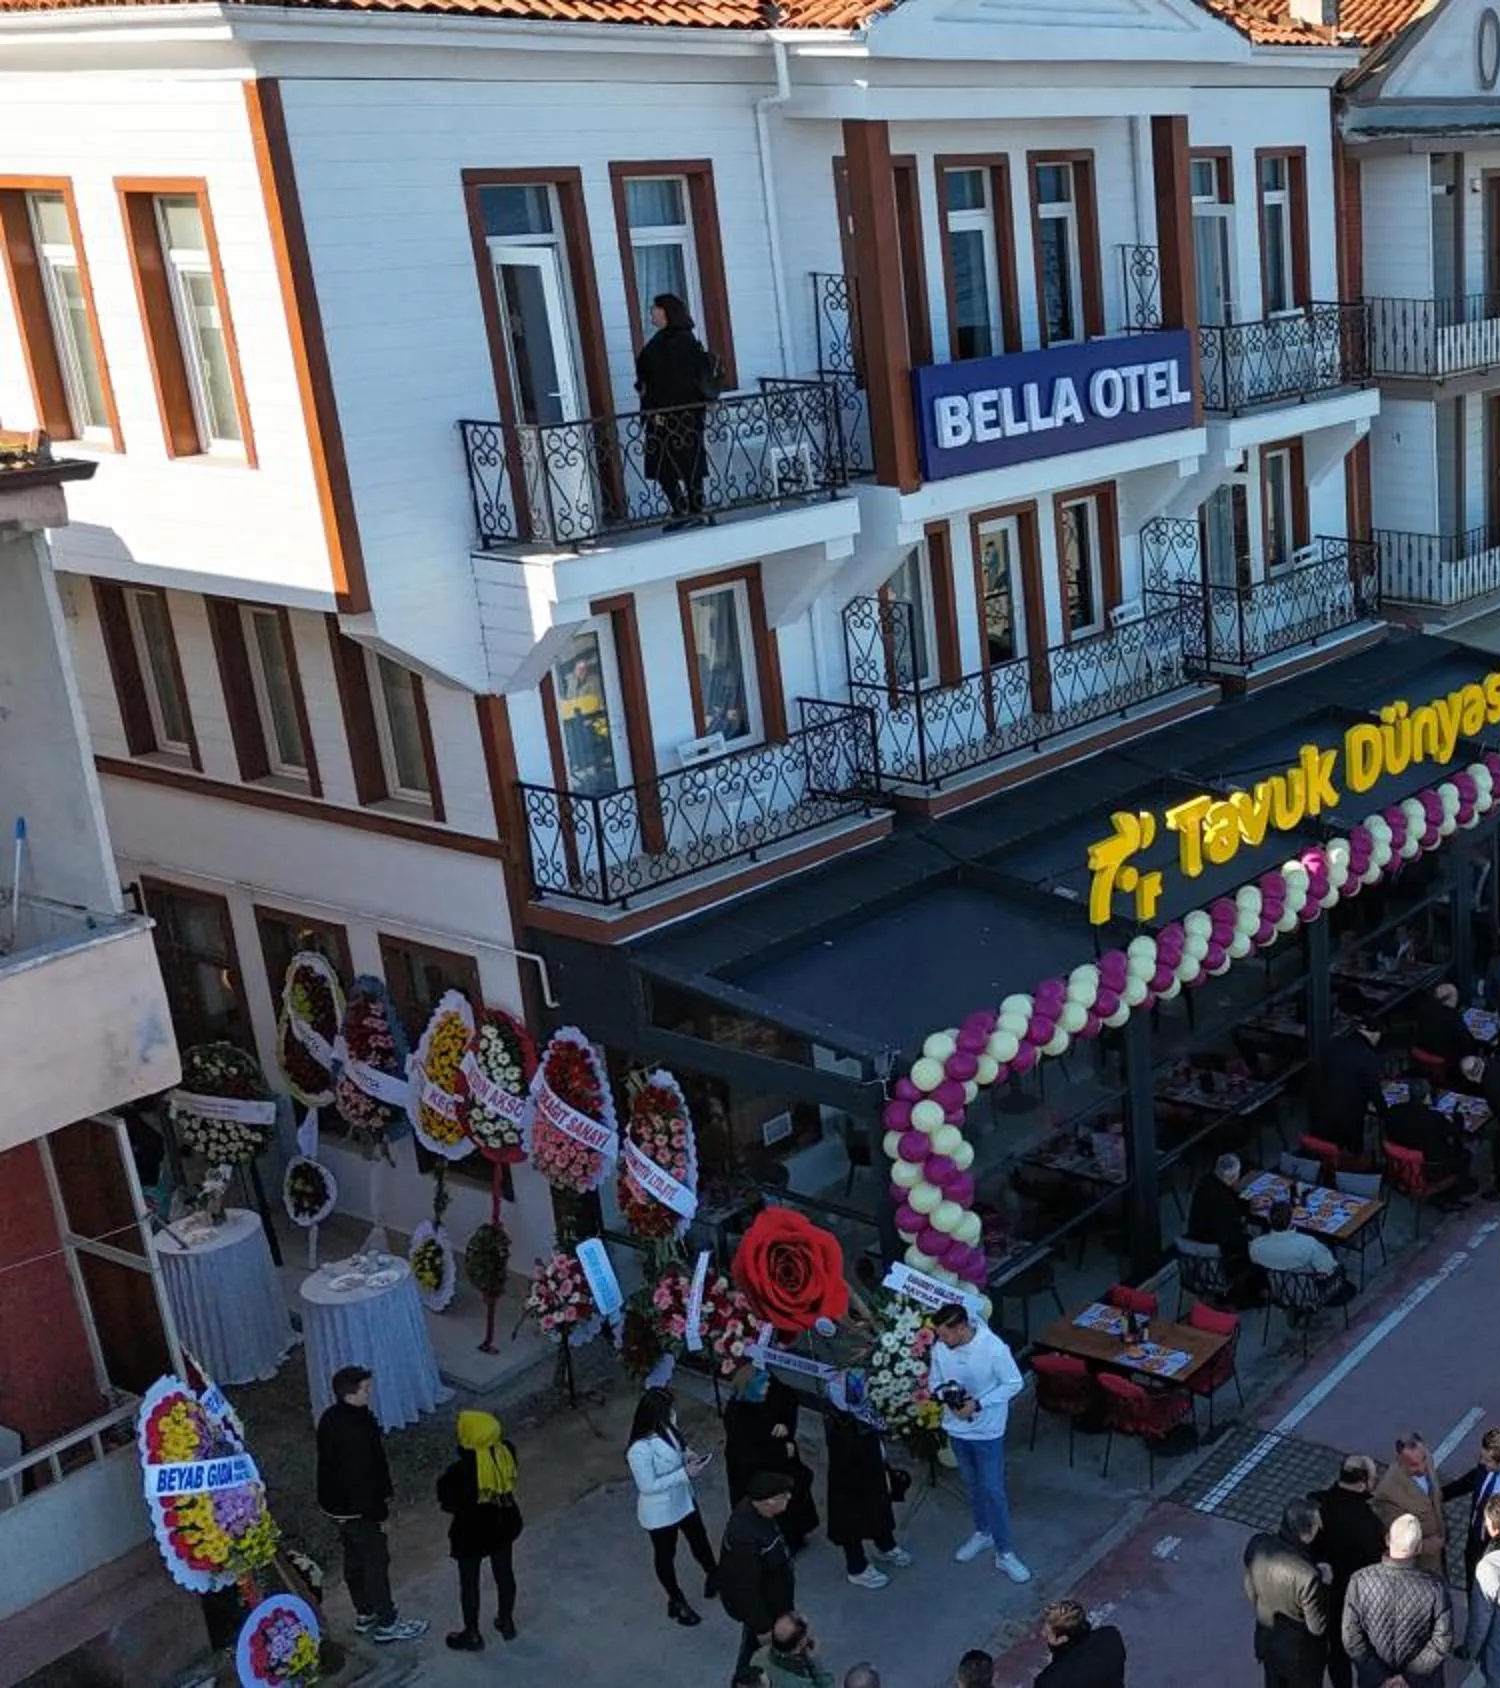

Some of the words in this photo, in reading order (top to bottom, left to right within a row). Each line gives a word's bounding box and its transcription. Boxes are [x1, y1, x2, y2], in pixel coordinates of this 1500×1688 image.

[933, 376, 1085, 449] BELLA
[1089, 358, 1192, 419] OTEL
[1165, 743, 1341, 878] Tavuk
[156, 1465, 205, 1493] BEYAB
